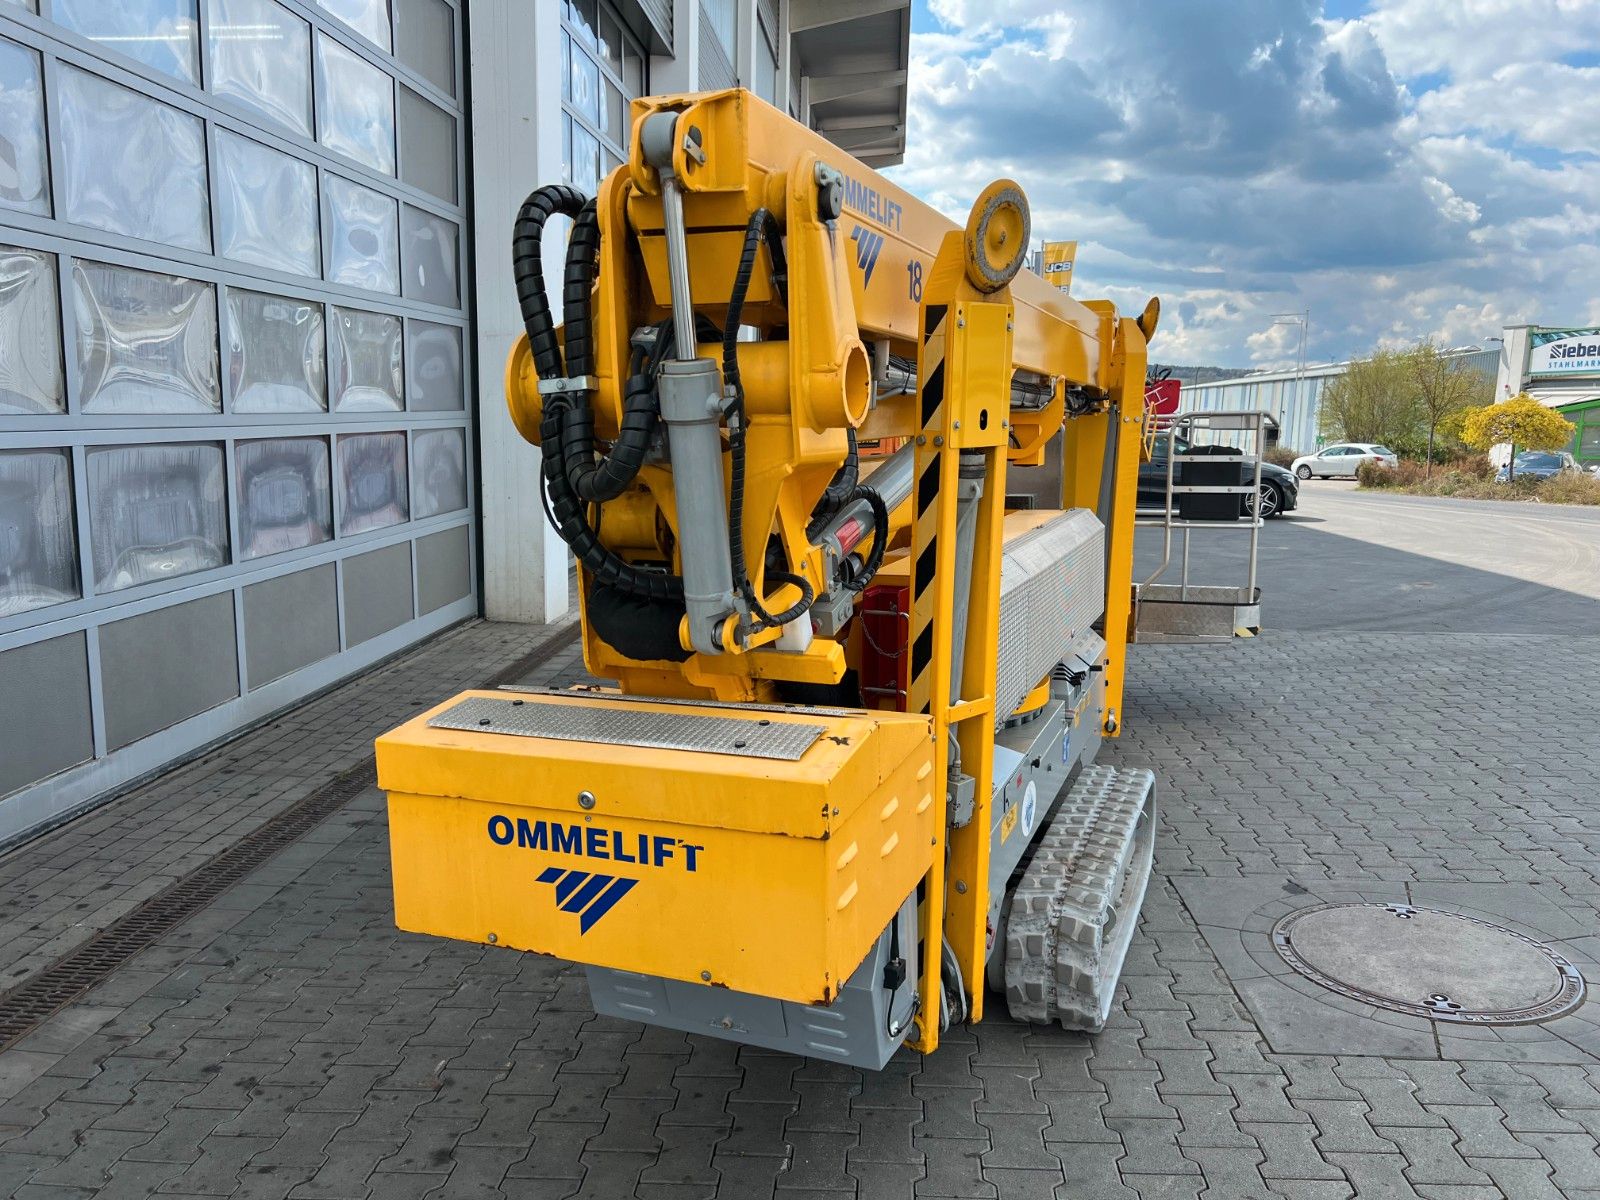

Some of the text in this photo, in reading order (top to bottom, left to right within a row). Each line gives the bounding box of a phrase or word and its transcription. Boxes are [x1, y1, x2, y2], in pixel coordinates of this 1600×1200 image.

[840, 175, 902, 232] MMELIFT
[907, 259, 922, 303] 18
[1045, 261, 1072, 273] JCB
[487, 814, 705, 872] OMMELIFT
